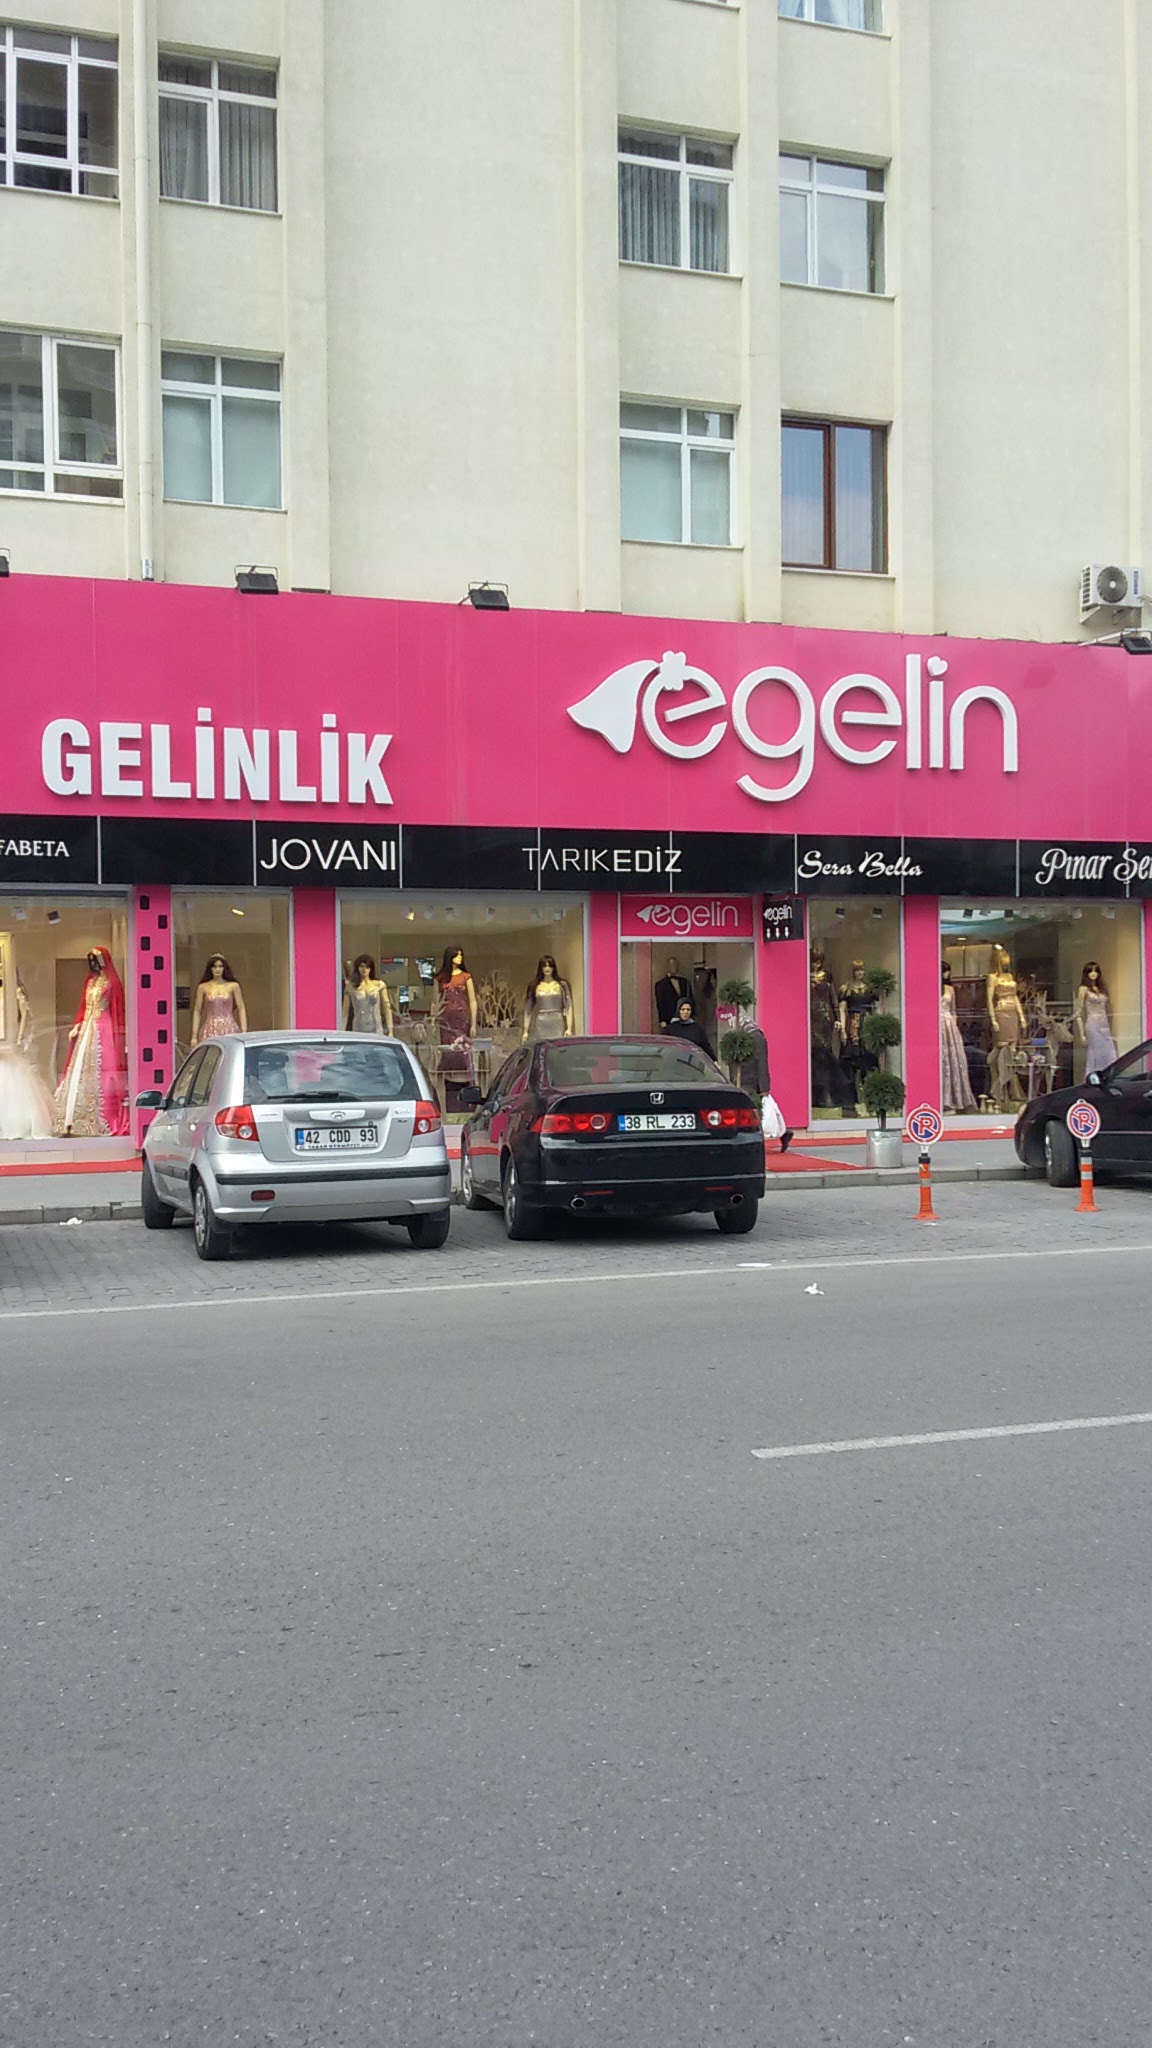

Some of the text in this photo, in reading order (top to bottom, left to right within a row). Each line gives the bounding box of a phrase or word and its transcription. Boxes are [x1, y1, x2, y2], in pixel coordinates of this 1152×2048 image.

[641, 651, 1019, 802] egelin
[41, 707, 394, 805] GELİNLİK
[260, 838, 396, 871] JOVANI
[797, 850, 924, 878] Sera Bella
[1035, 848, 1113, 885] Pınar
[651, 901, 739, 935] egelin
[767, 904, 793, 925] egelin
[305, 1129, 375, 1144] 42 CDD 93
[626, 1115, 694, 1129] 38 RL 233
